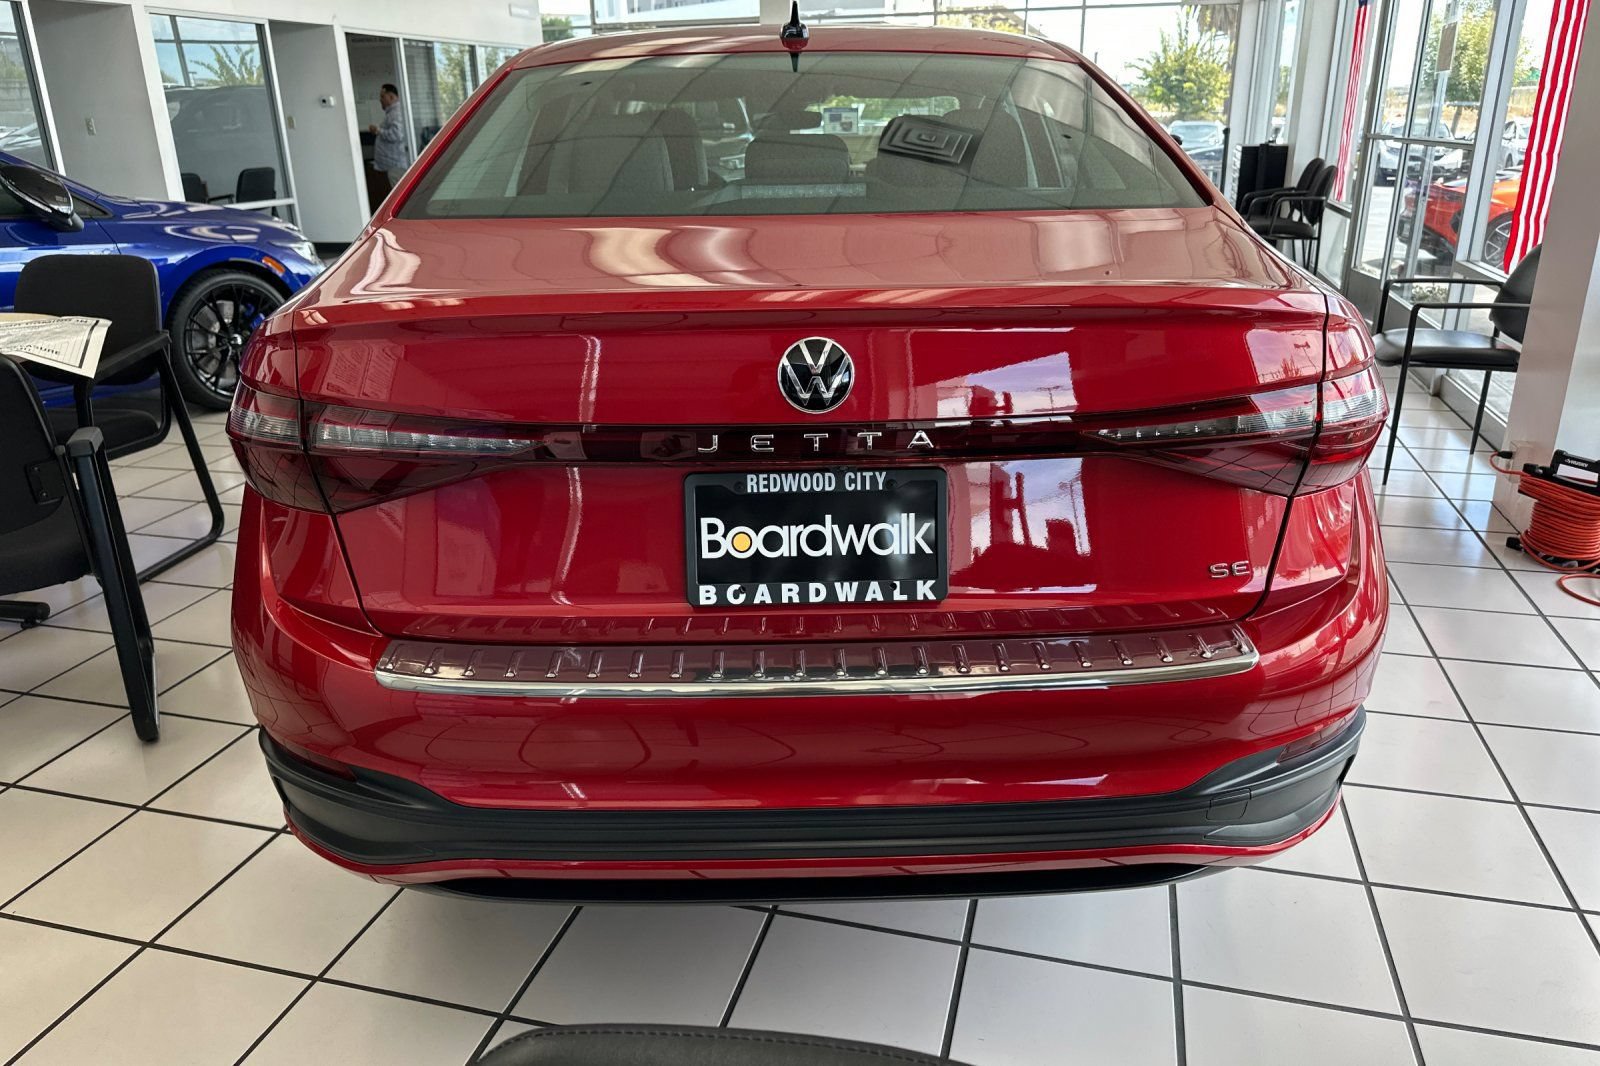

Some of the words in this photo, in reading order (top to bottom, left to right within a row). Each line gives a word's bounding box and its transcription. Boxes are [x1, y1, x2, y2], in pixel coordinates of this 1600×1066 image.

[780, 339, 850, 406] VW
[698, 430, 934, 452] JETTA
[747, 472, 836, 493] REDWOOD
[844, 471, 887, 491] CITY
[700, 512, 934, 559] Boardwalk
[1210, 560, 1250, 578] SE
[699, 579, 937, 605] BOARDWALK
